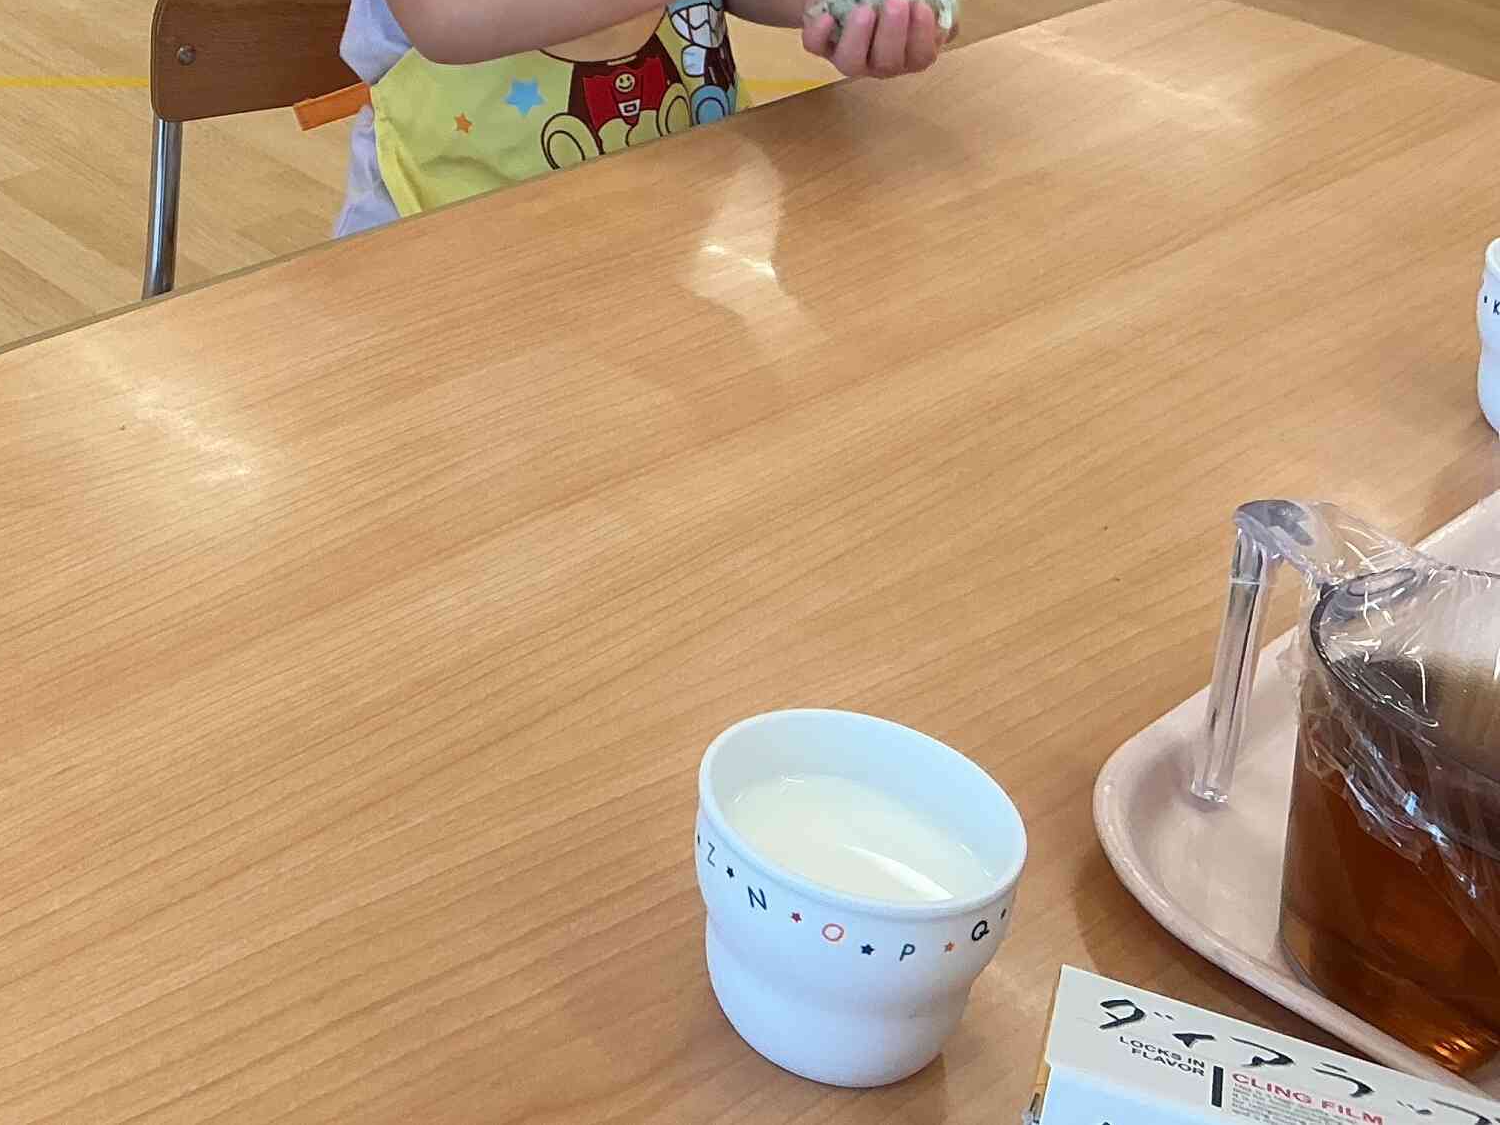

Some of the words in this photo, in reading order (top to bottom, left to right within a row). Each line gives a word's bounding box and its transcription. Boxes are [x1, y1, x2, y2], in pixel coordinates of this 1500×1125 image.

[747, 885, 767, 911] N
[821, 923, 844, 942] O
[899, 943, 916, 962] P
[971, 920, 990, 941] Q
[1119, 1035, 1182, 1061] LOCKS
[1187, 1057, 1205, 1069] IN
[1131, 1047, 1205, 1077] FLAVOR
[1232, 1073, 1312, 1104] CLING
[1321, 1099, 1383, 1125] FILM
